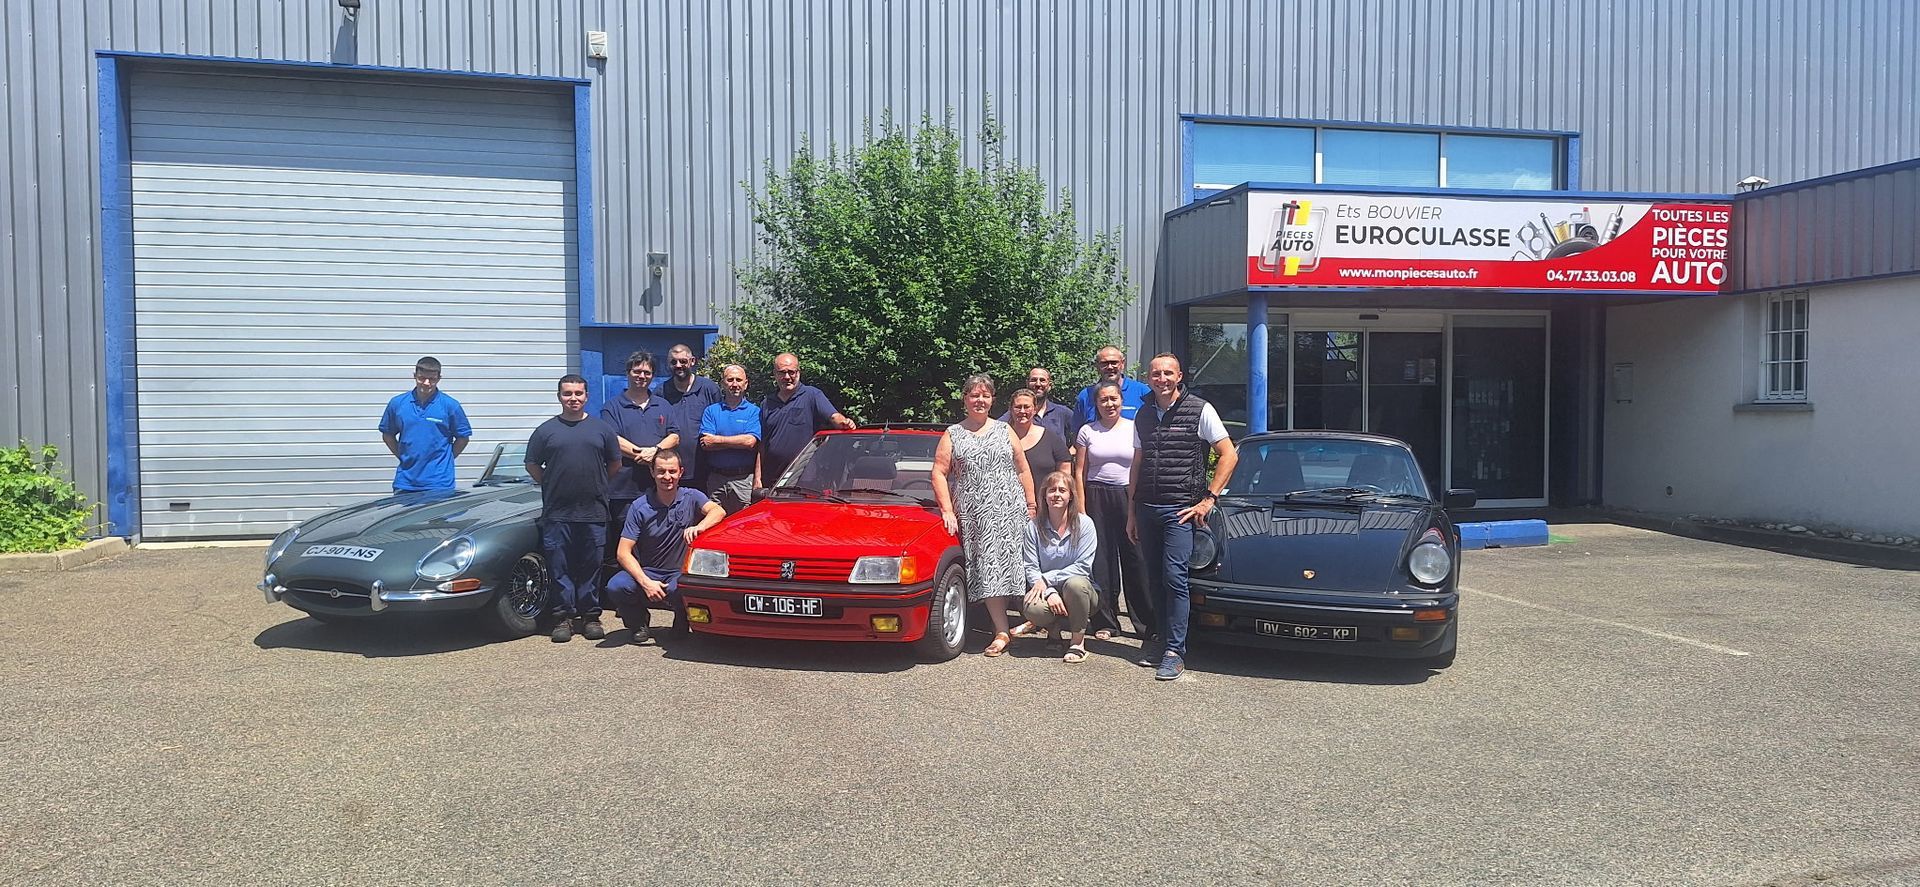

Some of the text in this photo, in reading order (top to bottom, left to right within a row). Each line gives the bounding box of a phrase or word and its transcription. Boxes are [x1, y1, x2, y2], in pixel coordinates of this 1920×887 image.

[1336, 204, 1443, 220] Ets BOUVIER
[1651, 209, 1729, 223] TOUTES LES
[1275, 230, 1314, 239] PIECES
[1335, 224, 1511, 247] EUROCULASSE
[1652, 222, 1728, 248] PIÈCES
[1270, 239, 1315, 252] AUTO
[1651, 247, 1728, 260] POUR VOTRE
[1338, 267, 1479, 280] www.monpiecesauto.fr
[1546, 269, 1637, 283] 04.77.33.03.08
[1650, 260, 1728, 285] AUTO
[305, 546, 377, 559] CJ-901-NS
